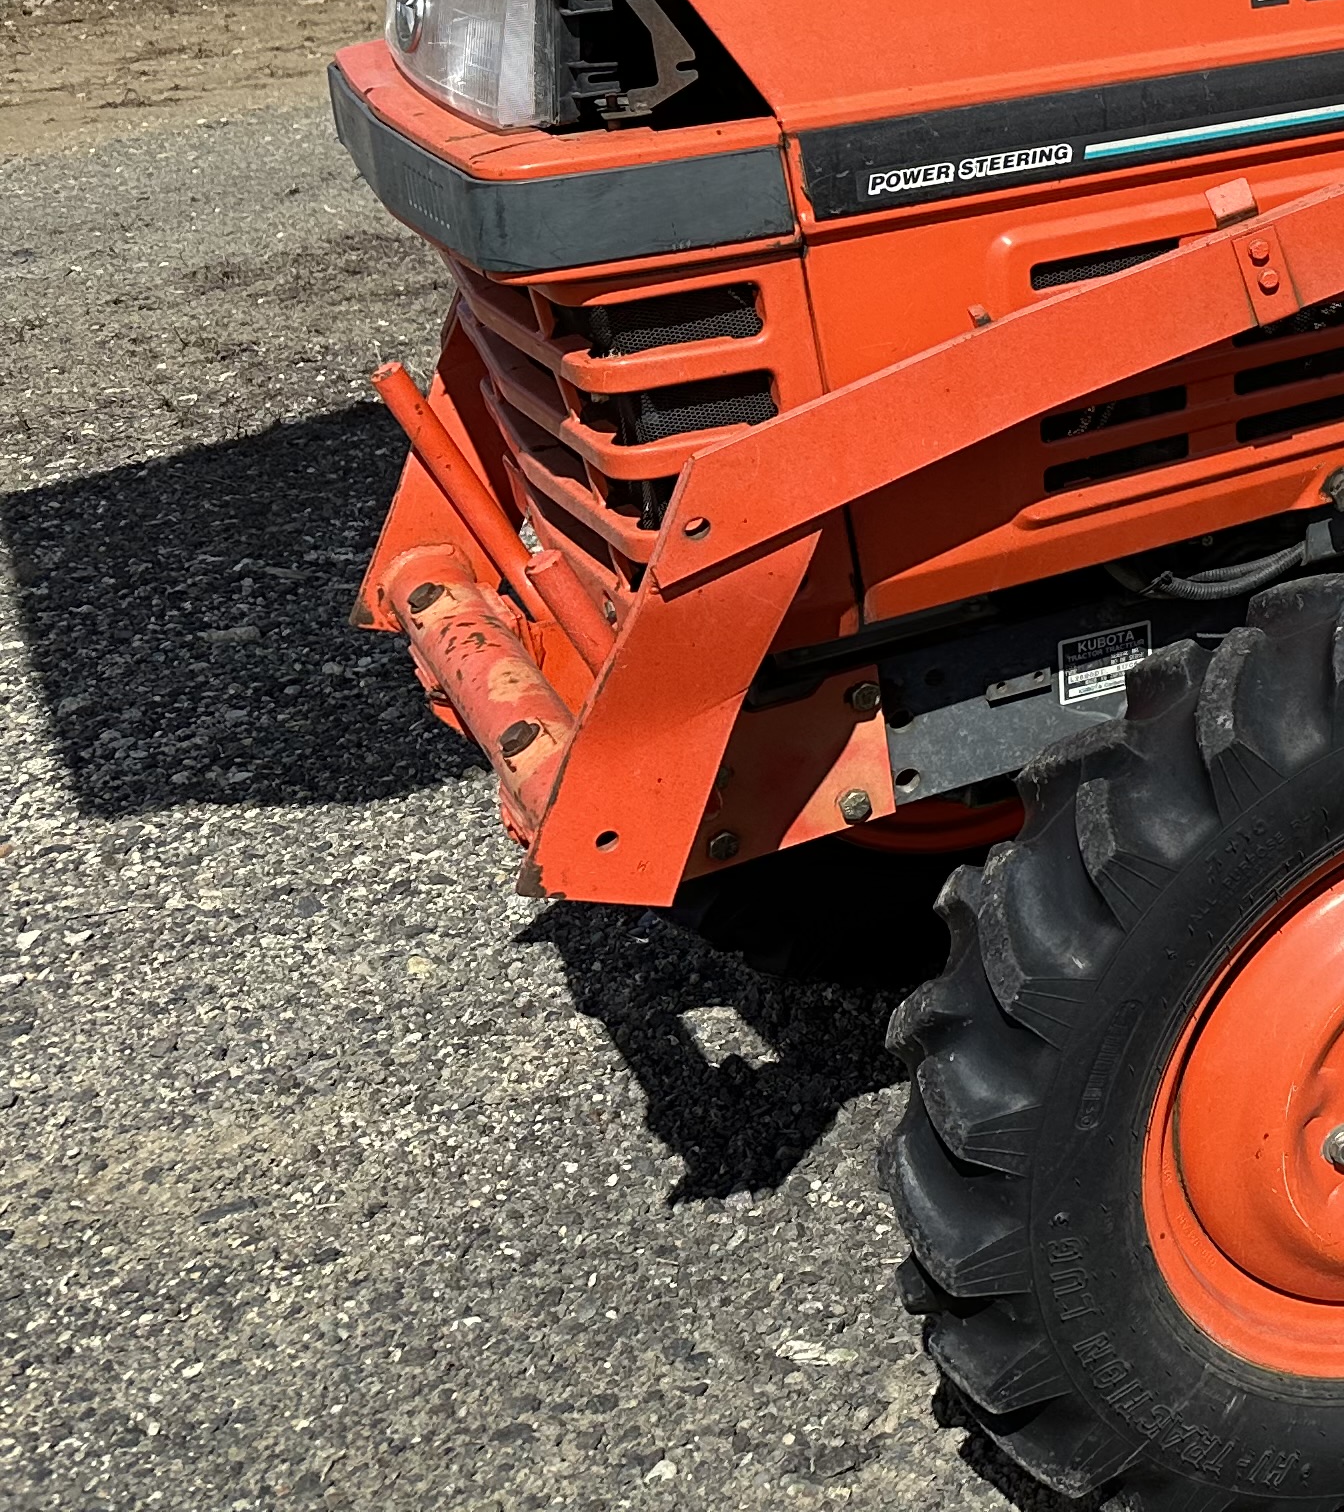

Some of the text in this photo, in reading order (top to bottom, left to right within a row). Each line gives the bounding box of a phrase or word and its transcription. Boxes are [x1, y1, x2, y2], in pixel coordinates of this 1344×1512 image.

[866, 143, 1073, 197] POWER STEERING
[1066, 649, 1103, 663] TRACTOR
[1077, 630, 1135, 653] KUBOTA
[1220, 830, 1285, 890] PURPOSE
[1047, 1236, 1098, 1323] LUG
